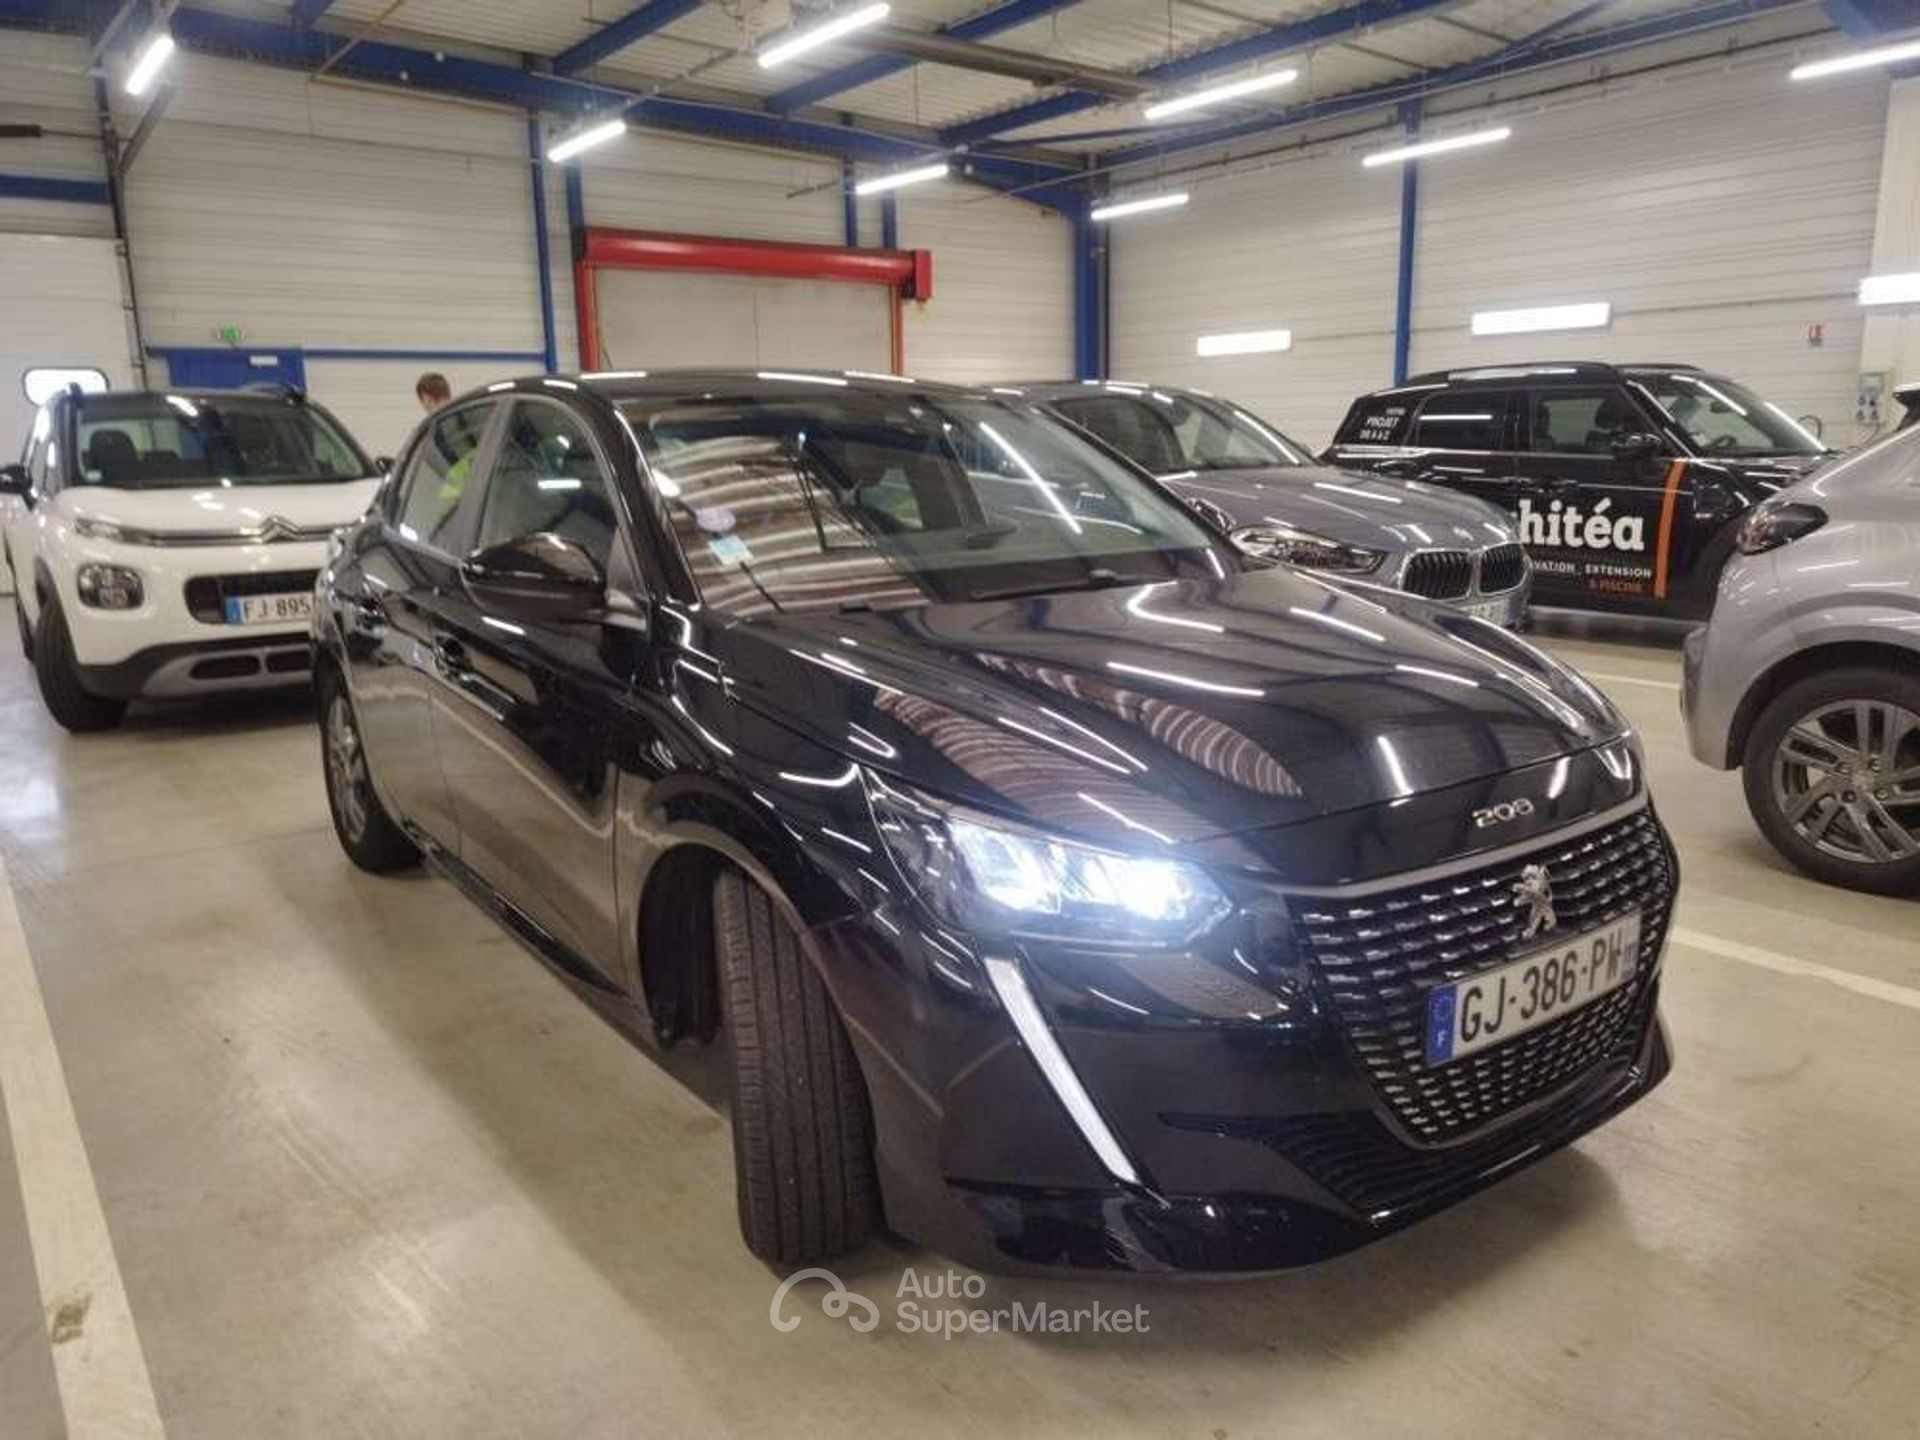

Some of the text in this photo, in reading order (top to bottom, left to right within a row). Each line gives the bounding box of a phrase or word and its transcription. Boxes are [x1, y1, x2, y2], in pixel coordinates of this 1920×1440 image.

[1512, 497, 1645, 551] hitéa
[1585, 563, 1651, 579] EXTENSION
[1473, 799, 1534, 828] 208
